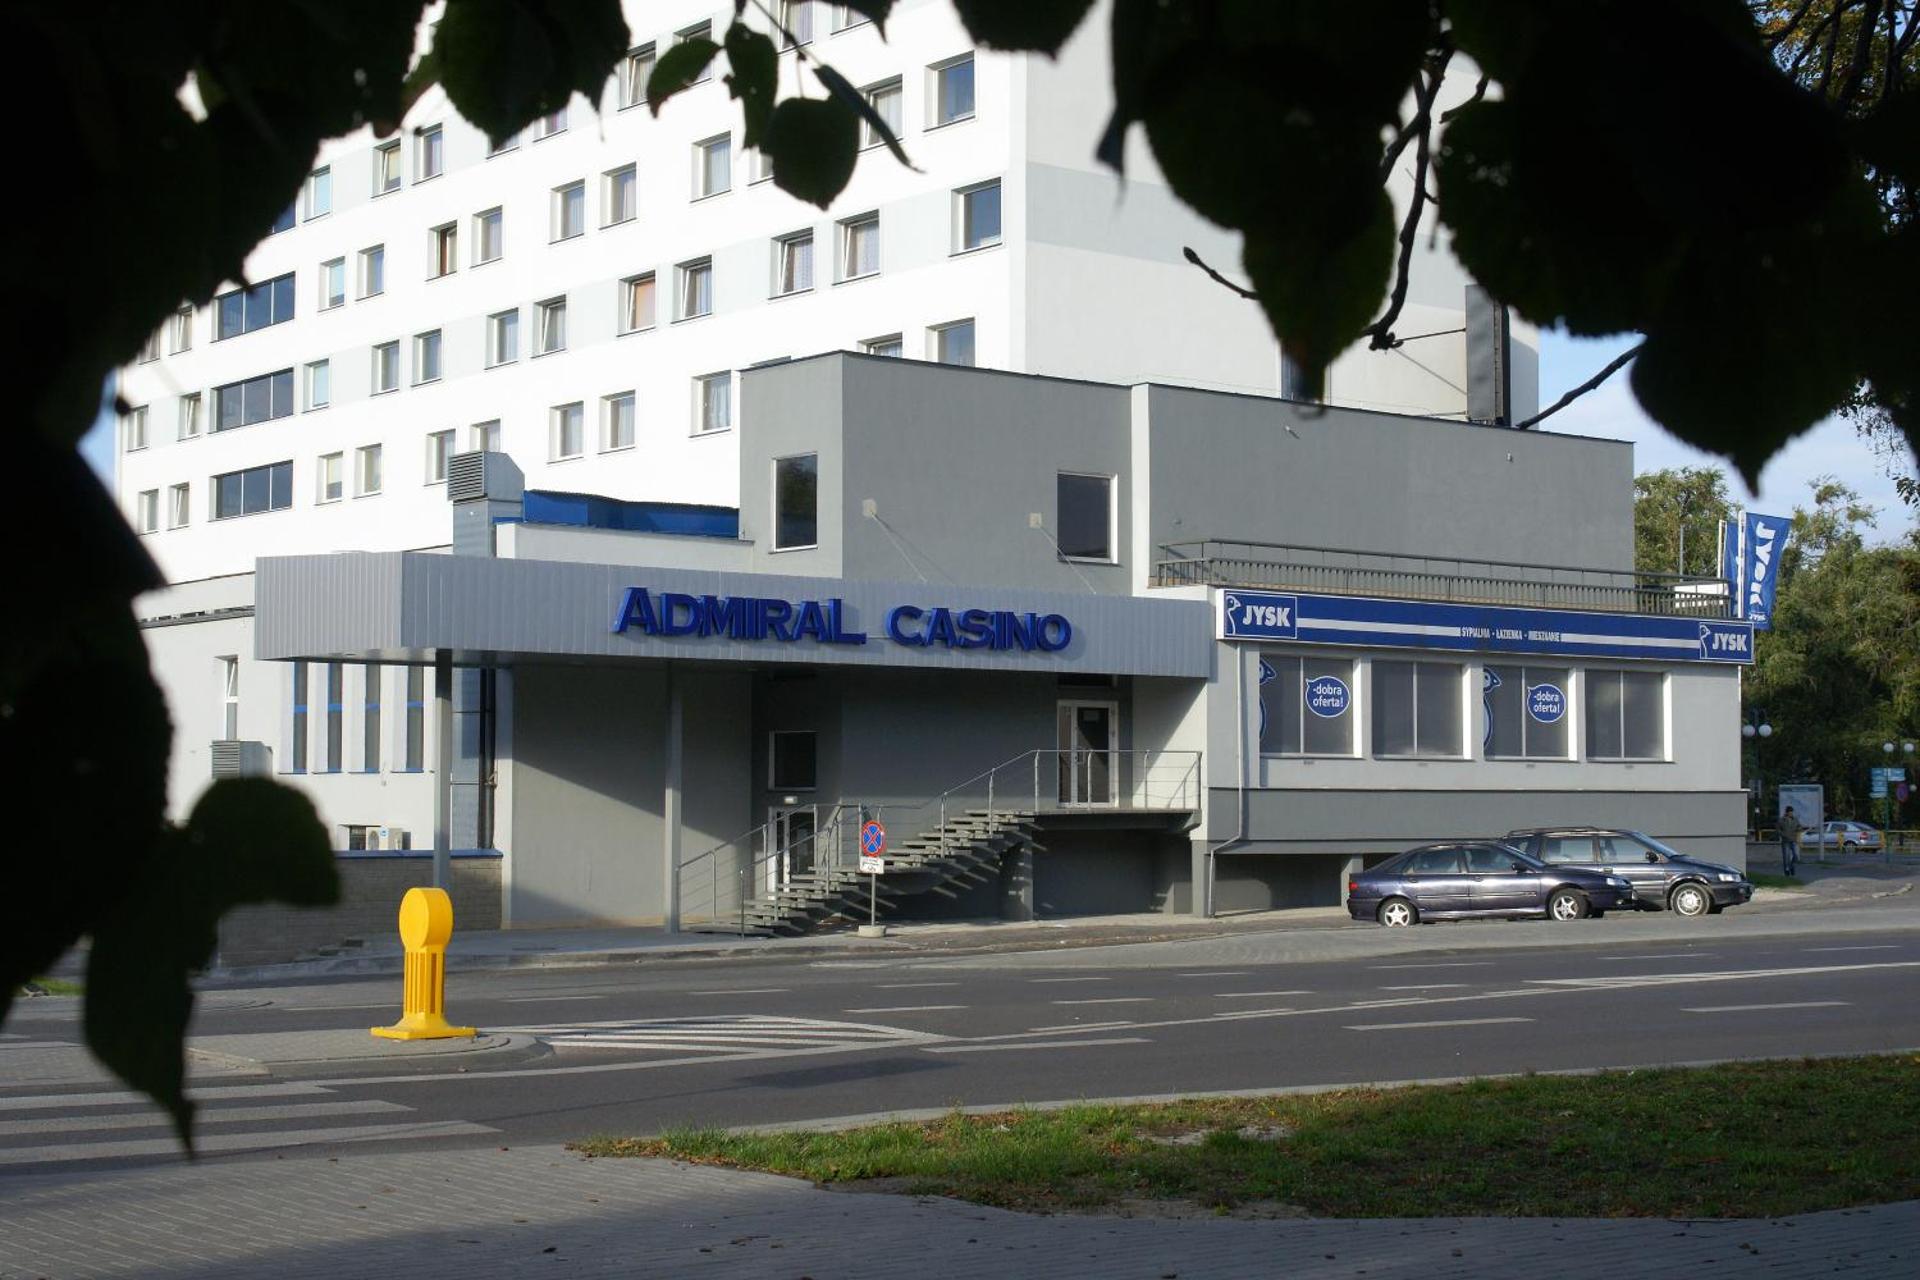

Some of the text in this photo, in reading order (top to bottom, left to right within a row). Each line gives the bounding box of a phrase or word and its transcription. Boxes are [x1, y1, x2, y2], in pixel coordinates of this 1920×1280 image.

[612, 586, 1073, 652] ADMIRAL CASINO
[1242, 604, 1291, 627] JYSK
[1712, 632, 1748, 652] JYSK
[1312, 695, 1344, 708] oferta!
